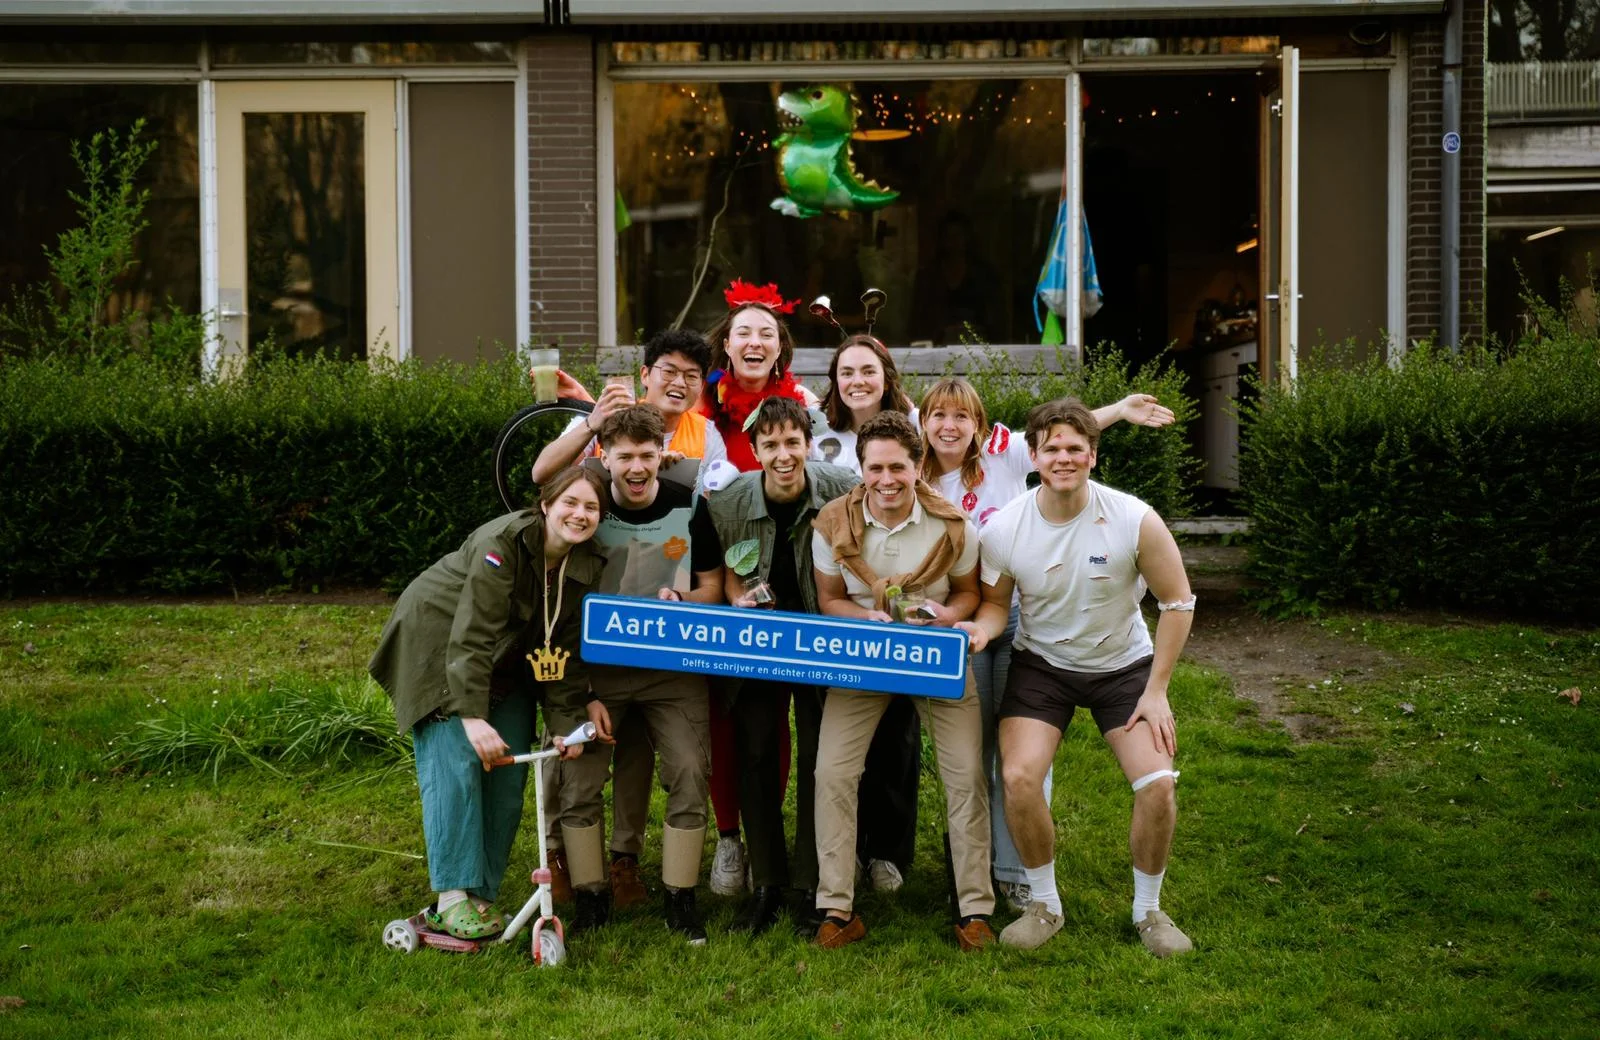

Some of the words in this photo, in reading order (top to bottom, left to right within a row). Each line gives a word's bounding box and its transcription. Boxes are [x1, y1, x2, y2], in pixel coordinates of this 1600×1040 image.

[604, 611, 667, 639] Aart
[678, 622, 726, 644] van
[738, 624, 783, 649] der
[795, 629, 942, 665] Leeuwlaan
[540, 661, 559, 676] HJ
[682, 657, 710, 669] Delfts
[713, 662, 755, 674] schrijver
[772, 667, 806, 679] dichter
[807, 670, 861, 684] (1876-1931)
